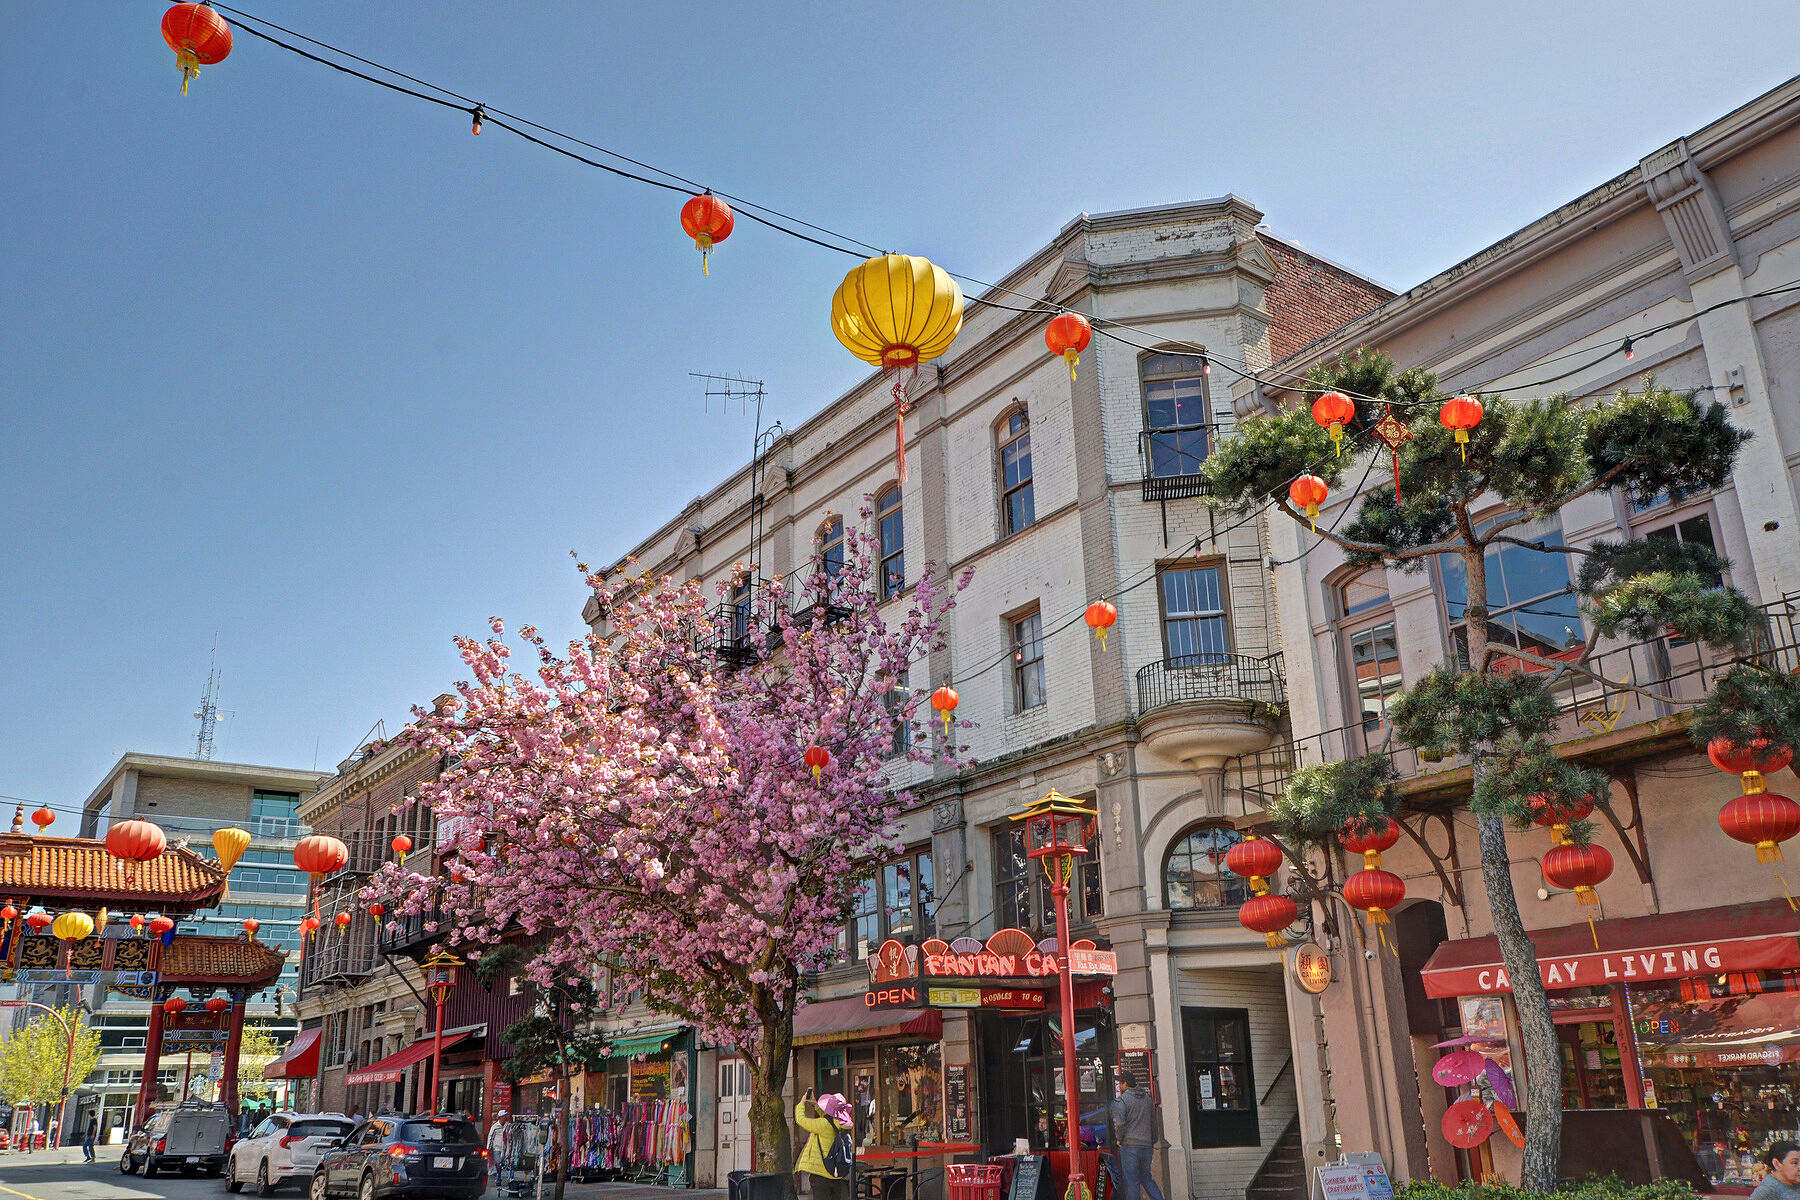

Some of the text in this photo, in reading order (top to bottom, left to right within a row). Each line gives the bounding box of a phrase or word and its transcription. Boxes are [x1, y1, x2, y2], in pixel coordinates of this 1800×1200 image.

[1386, 424, 1400, 438] 福
[925, 953, 1060, 977] FANTAN CA
[1478, 947, 1722, 991] CAAY LIVING
[864, 986, 916, 1007] OPEN
[983, 992, 1043, 1004] NOODLES TO GO
[1639, 1019, 1680, 1035] OPEN
[1325, 1175, 1346, 1186] CHINESE
